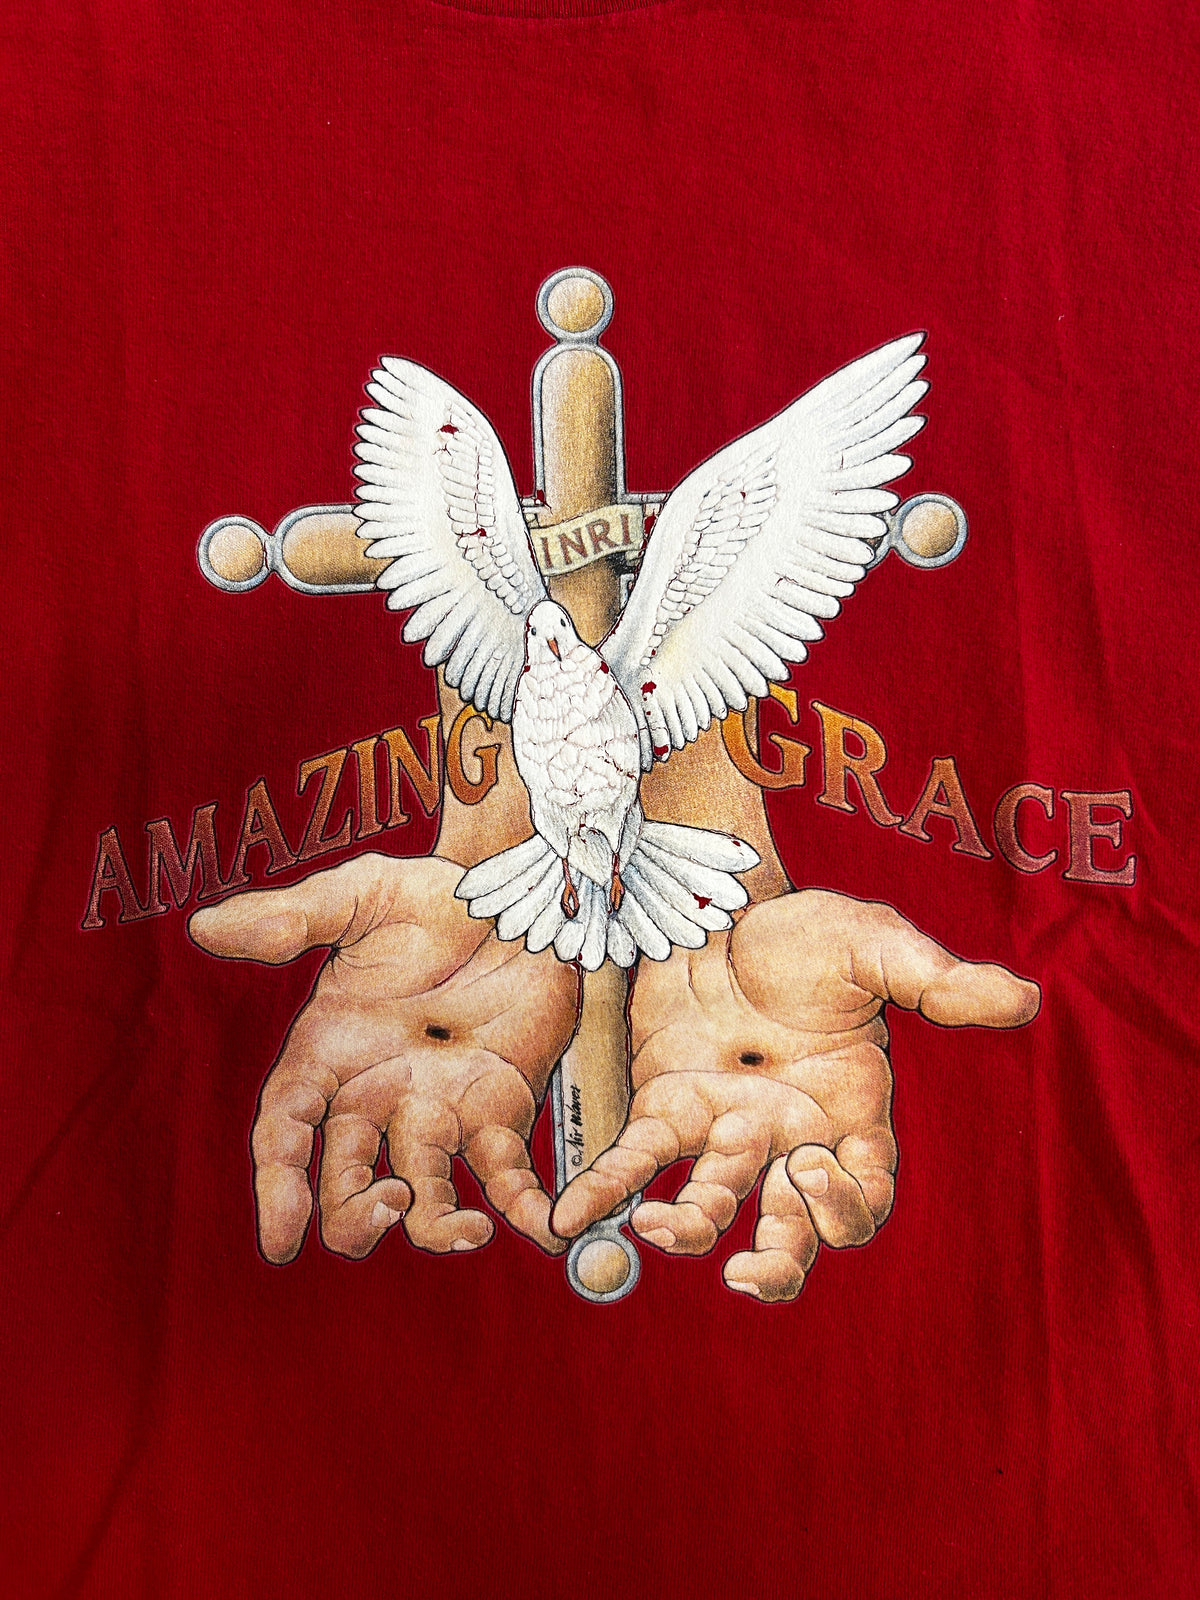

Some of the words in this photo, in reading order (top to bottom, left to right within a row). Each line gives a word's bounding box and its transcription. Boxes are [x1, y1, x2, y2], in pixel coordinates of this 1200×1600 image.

[539, 513, 633, 569] INRI
[80, 704, 500, 929] AMAZING
[720, 682, 1137, 886] GRACE
